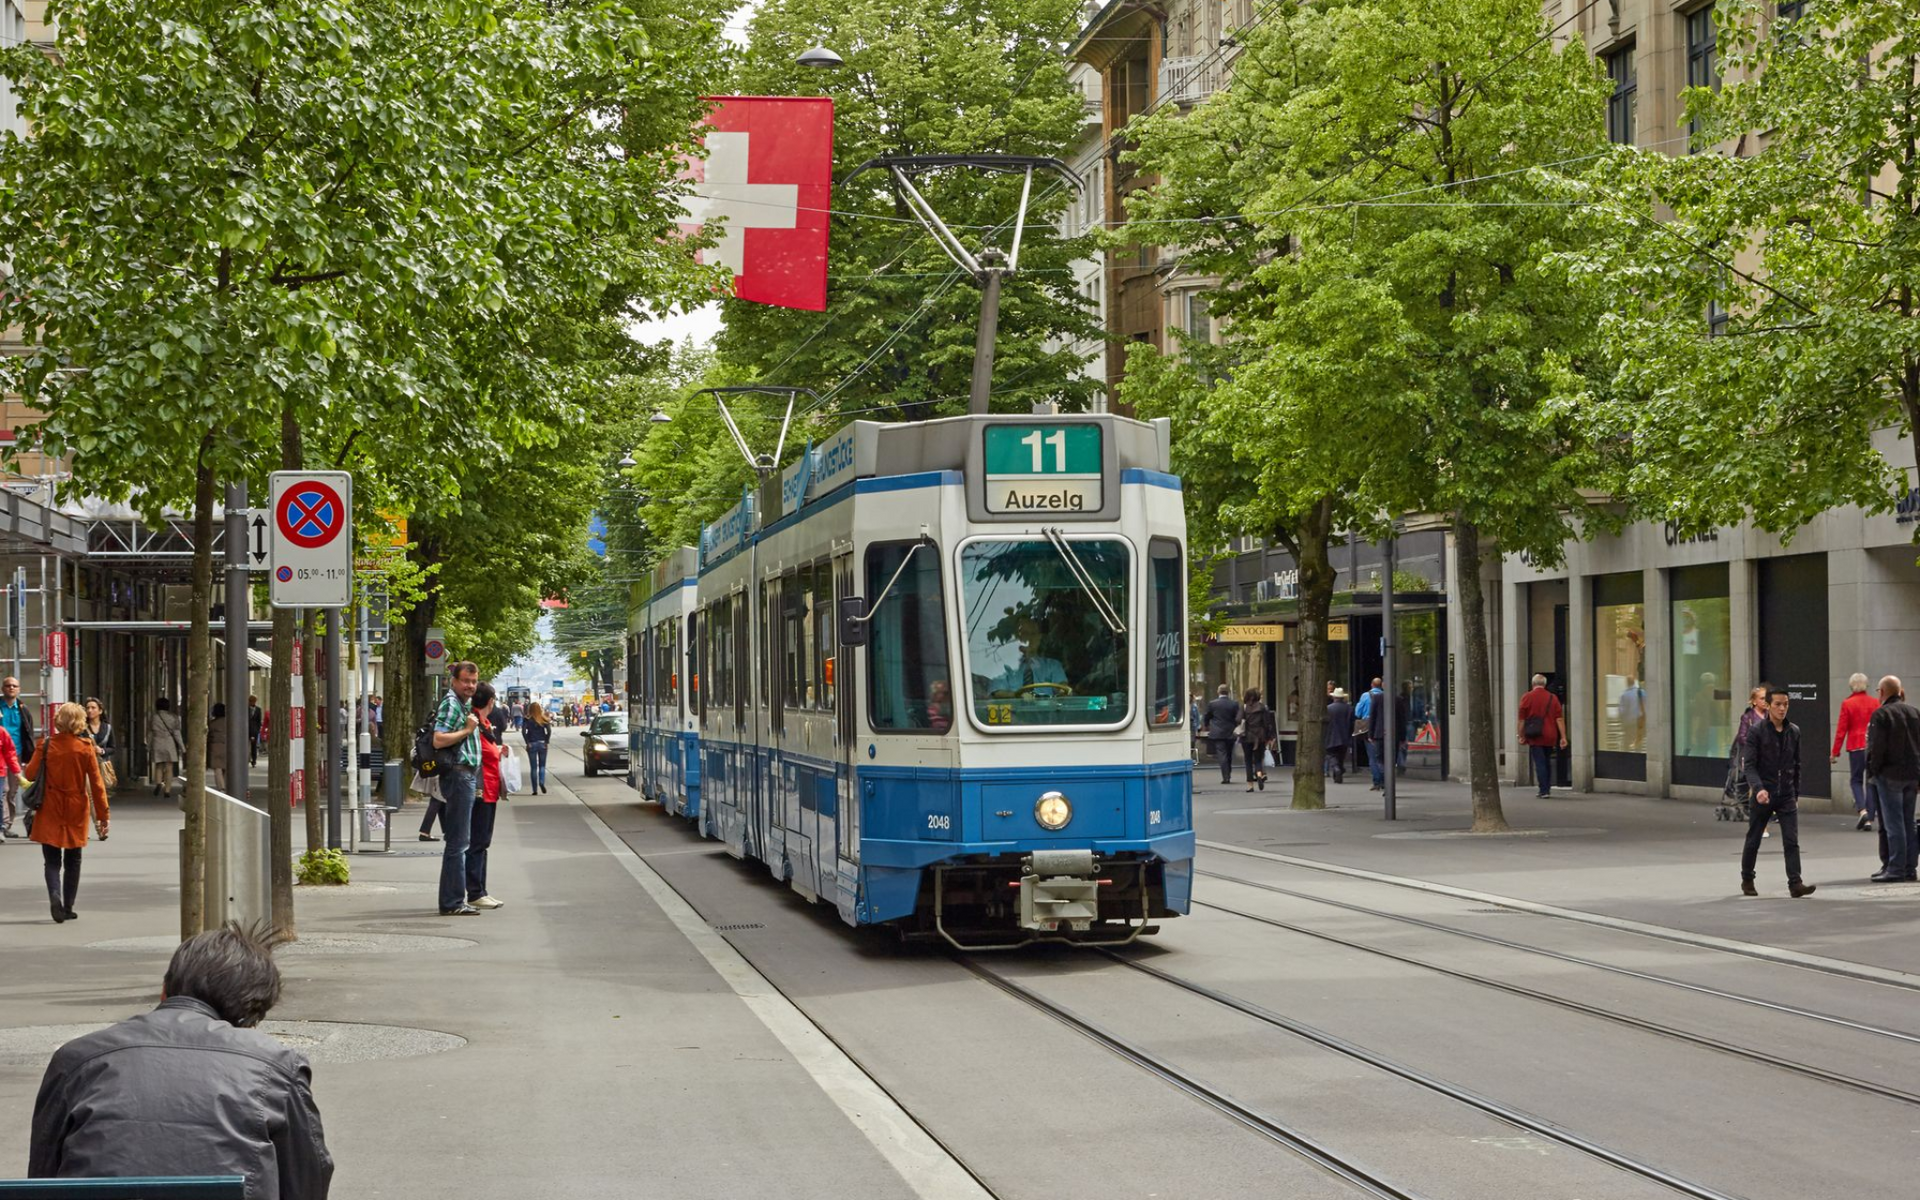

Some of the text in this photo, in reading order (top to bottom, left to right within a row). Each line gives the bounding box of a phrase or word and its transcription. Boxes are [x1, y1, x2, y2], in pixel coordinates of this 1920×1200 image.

[1021, 430, 1066, 472] 11
[1005, 490, 1083, 511] Auzelg
[298, 568, 319, 580] 05.00
[326, 568, 346, 580] 11.00
[1226, 626, 1275, 636] EN VOGUE
[988, 706, 1011, 721] 02
[928, 814, 950, 830] 2048
[1150, 810, 1161, 825] 2048
